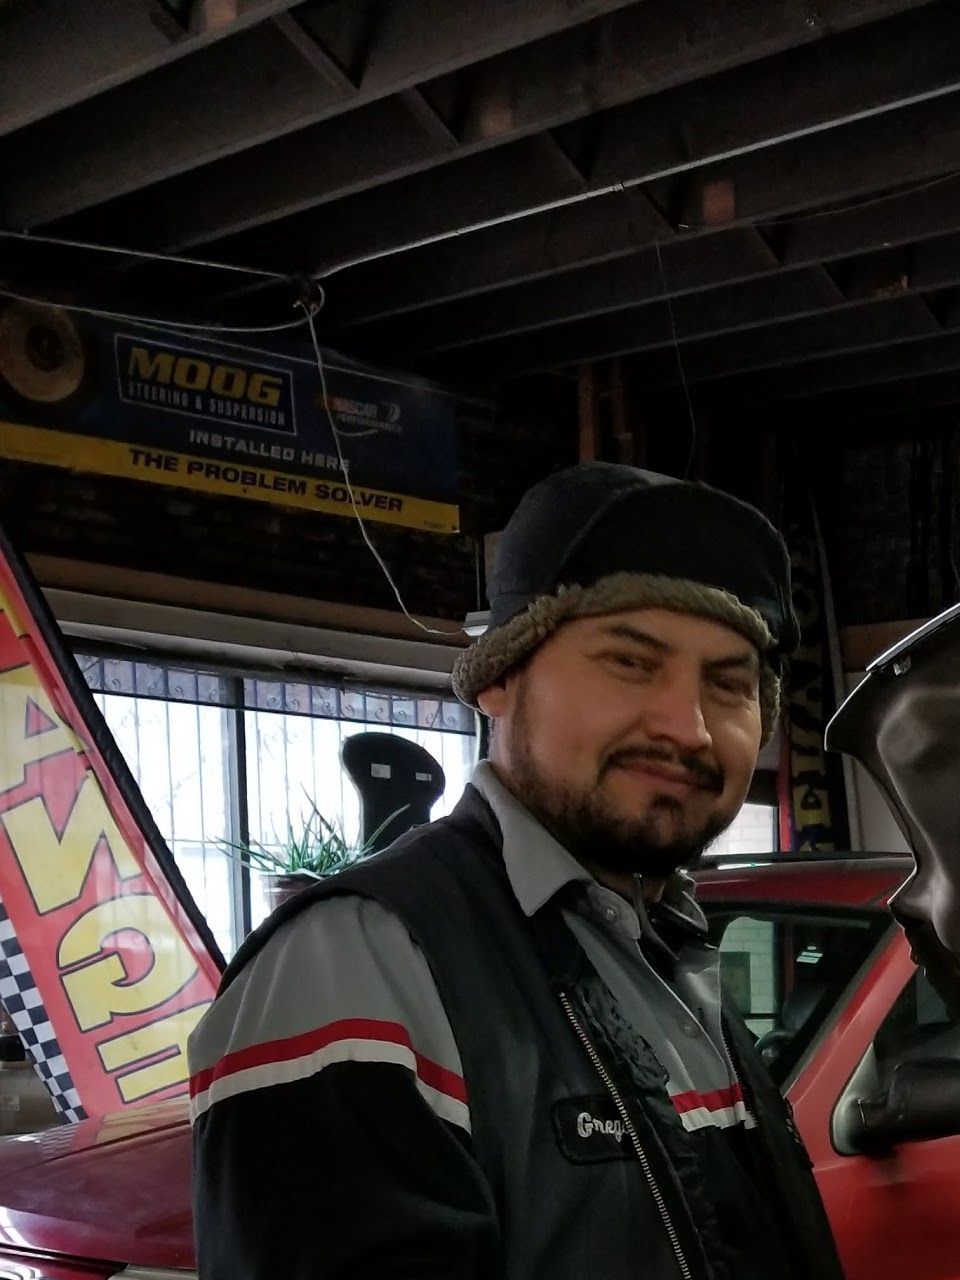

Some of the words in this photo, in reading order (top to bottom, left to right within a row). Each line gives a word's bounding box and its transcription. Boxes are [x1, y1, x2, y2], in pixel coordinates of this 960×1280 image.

[128, 346, 284, 408] MOOG
[129, 448, 178, 472] THE
[186, 460, 307, 497] PROBLEM
[315, 484, 403, 513] SOLVER
[188, 428, 295, 462] INSTALLED
[300, 450, 350, 472] HERE
